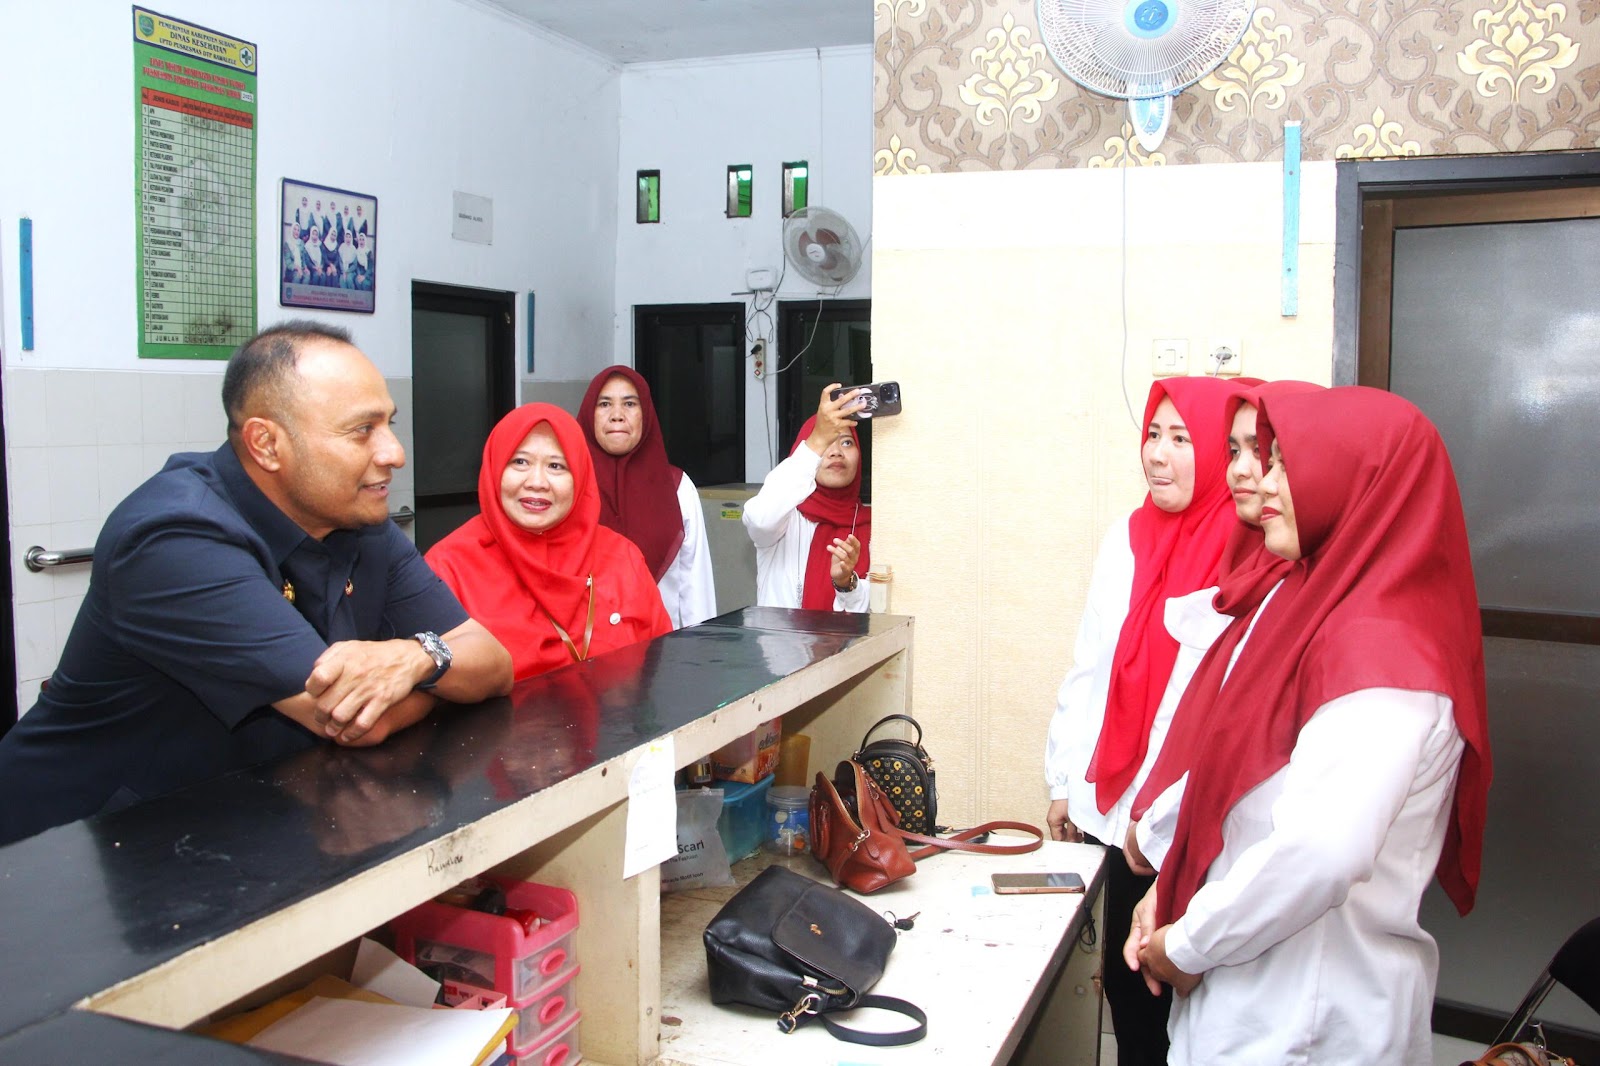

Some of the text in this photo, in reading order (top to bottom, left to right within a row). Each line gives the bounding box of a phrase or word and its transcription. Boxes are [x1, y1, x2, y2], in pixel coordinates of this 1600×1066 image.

[158, 21, 236, 49] PEMERINTAH KABUPATEN SUBANG
[159, 38, 172, 46] UPTD
[174, 42, 202, 54] PUSKESMAS
[170, 32, 226, 54] DINAS KESEHATAN
